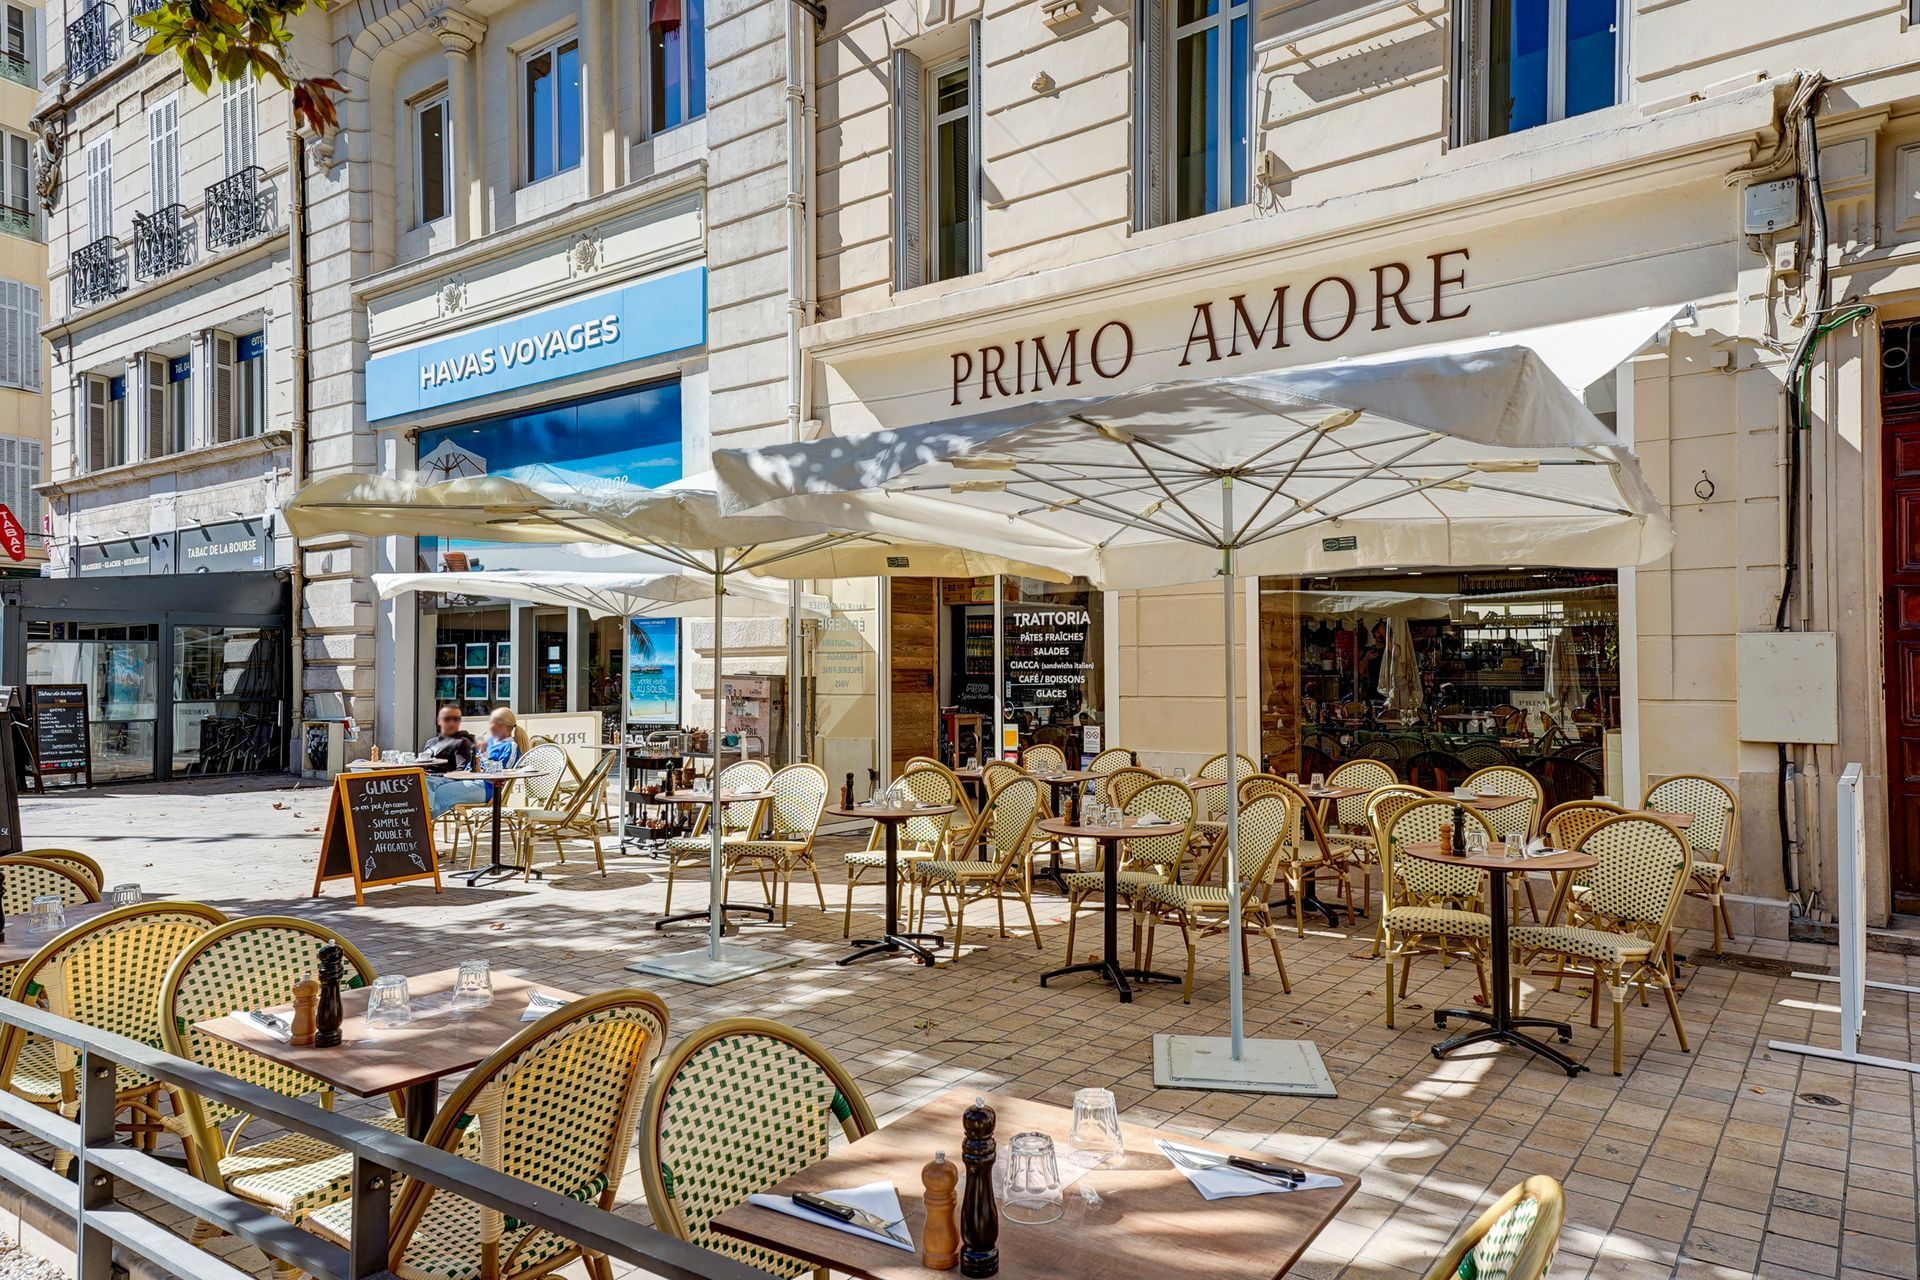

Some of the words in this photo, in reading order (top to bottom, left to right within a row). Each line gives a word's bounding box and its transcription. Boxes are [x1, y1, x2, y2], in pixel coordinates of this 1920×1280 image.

[951, 321, 1134, 406] PRIMO
[1178, 248, 1472, 367] AMORE
[421, 347, 496, 389] HAVAS
[500, 315, 620, 369] VOYAGES
[0, 511, 21, 554] TABAC
[188, 545, 208, 559] TABAC
[209, 543, 218, 555] DE
[219, 543, 228, 553] LA
[228, 539, 257, 553] BOURSE
[1013, 611, 1092, 626] TRATTORIA
[1020, 632, 1043, 642] PÂTES
[1045, 631, 1084, 641] FRAÎCHES
[1033, 647, 1070, 656] SALADES
[1010, 661, 1039, 669] CIACCA
[1018, 673, 1040, 683] CAFÉ
[1045, 675, 1086, 684] BOISSONS
[1036, 690, 1067, 698] GLACES
[365, 779, 409, 795] GLACES
[373, 818, 400, 828] SIMPLE
[374, 829, 403, 840] DOUBLE
[375, 842, 409, 852] AFFOGATO
